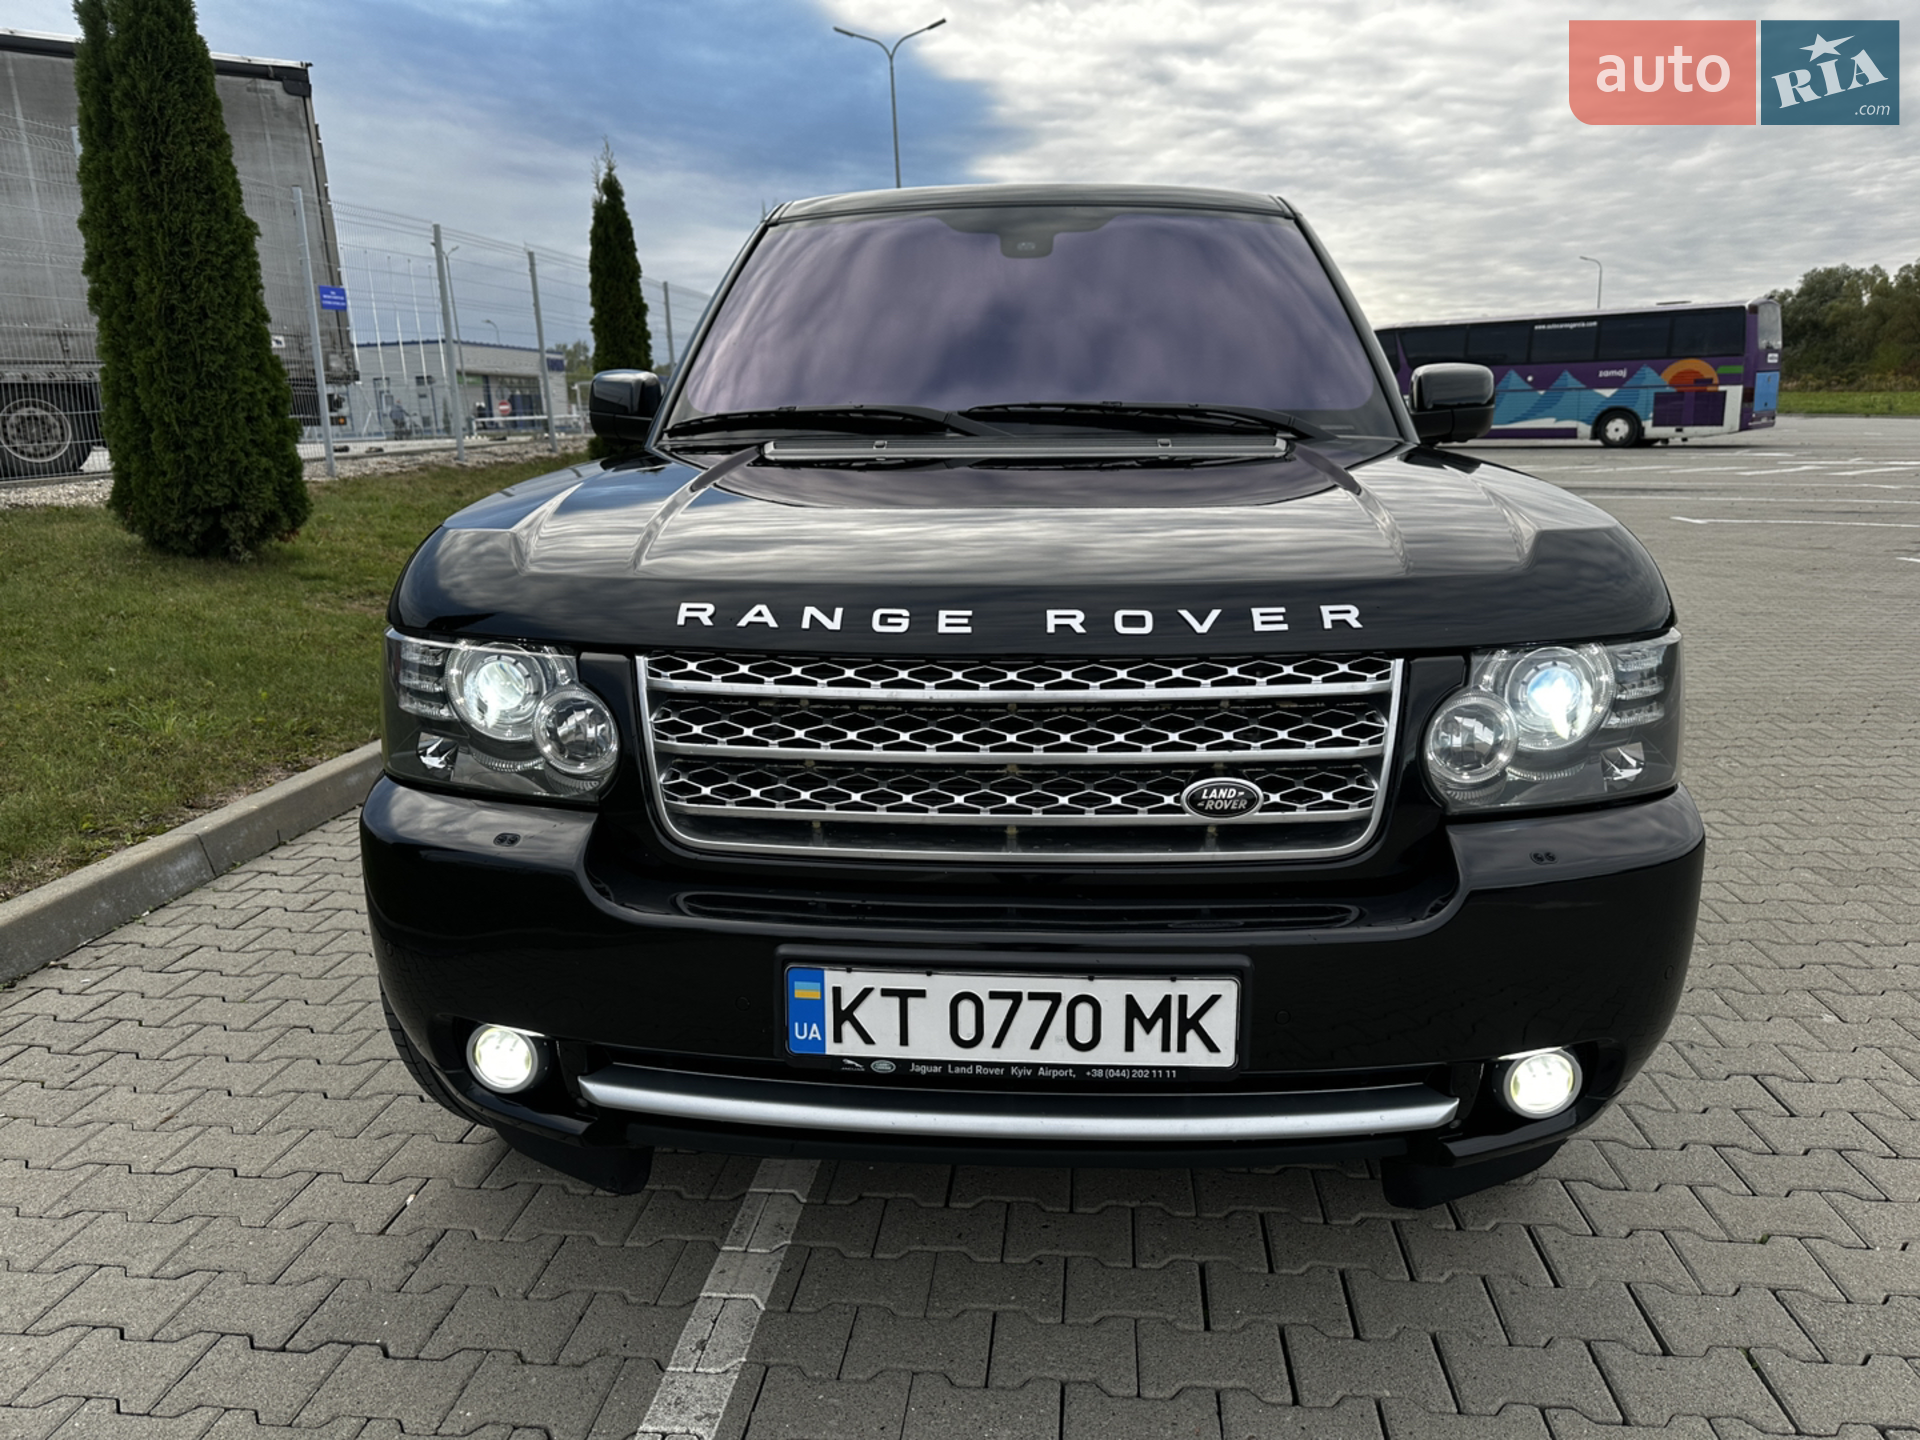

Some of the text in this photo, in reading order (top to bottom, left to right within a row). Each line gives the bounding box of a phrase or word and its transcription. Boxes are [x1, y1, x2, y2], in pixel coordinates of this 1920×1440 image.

[676, 602, 1364, 635] RANGE ROVER
[1201, 788, 1237, 799] LAND
[1204, 800, 1248, 810] ROVER
[832, 986, 1223, 1053] KT 0770 MK
[794, 1022, 822, 1041] UA
[909, 1062, 942, 1074] Jaguar
[948, 1063, 973, 1074] Land
[975, 1065, 1004, 1076] Rover
[1011, 1067, 1033, 1078] Kyiv
[1037, 1066, 1076, 1079] Airport,
